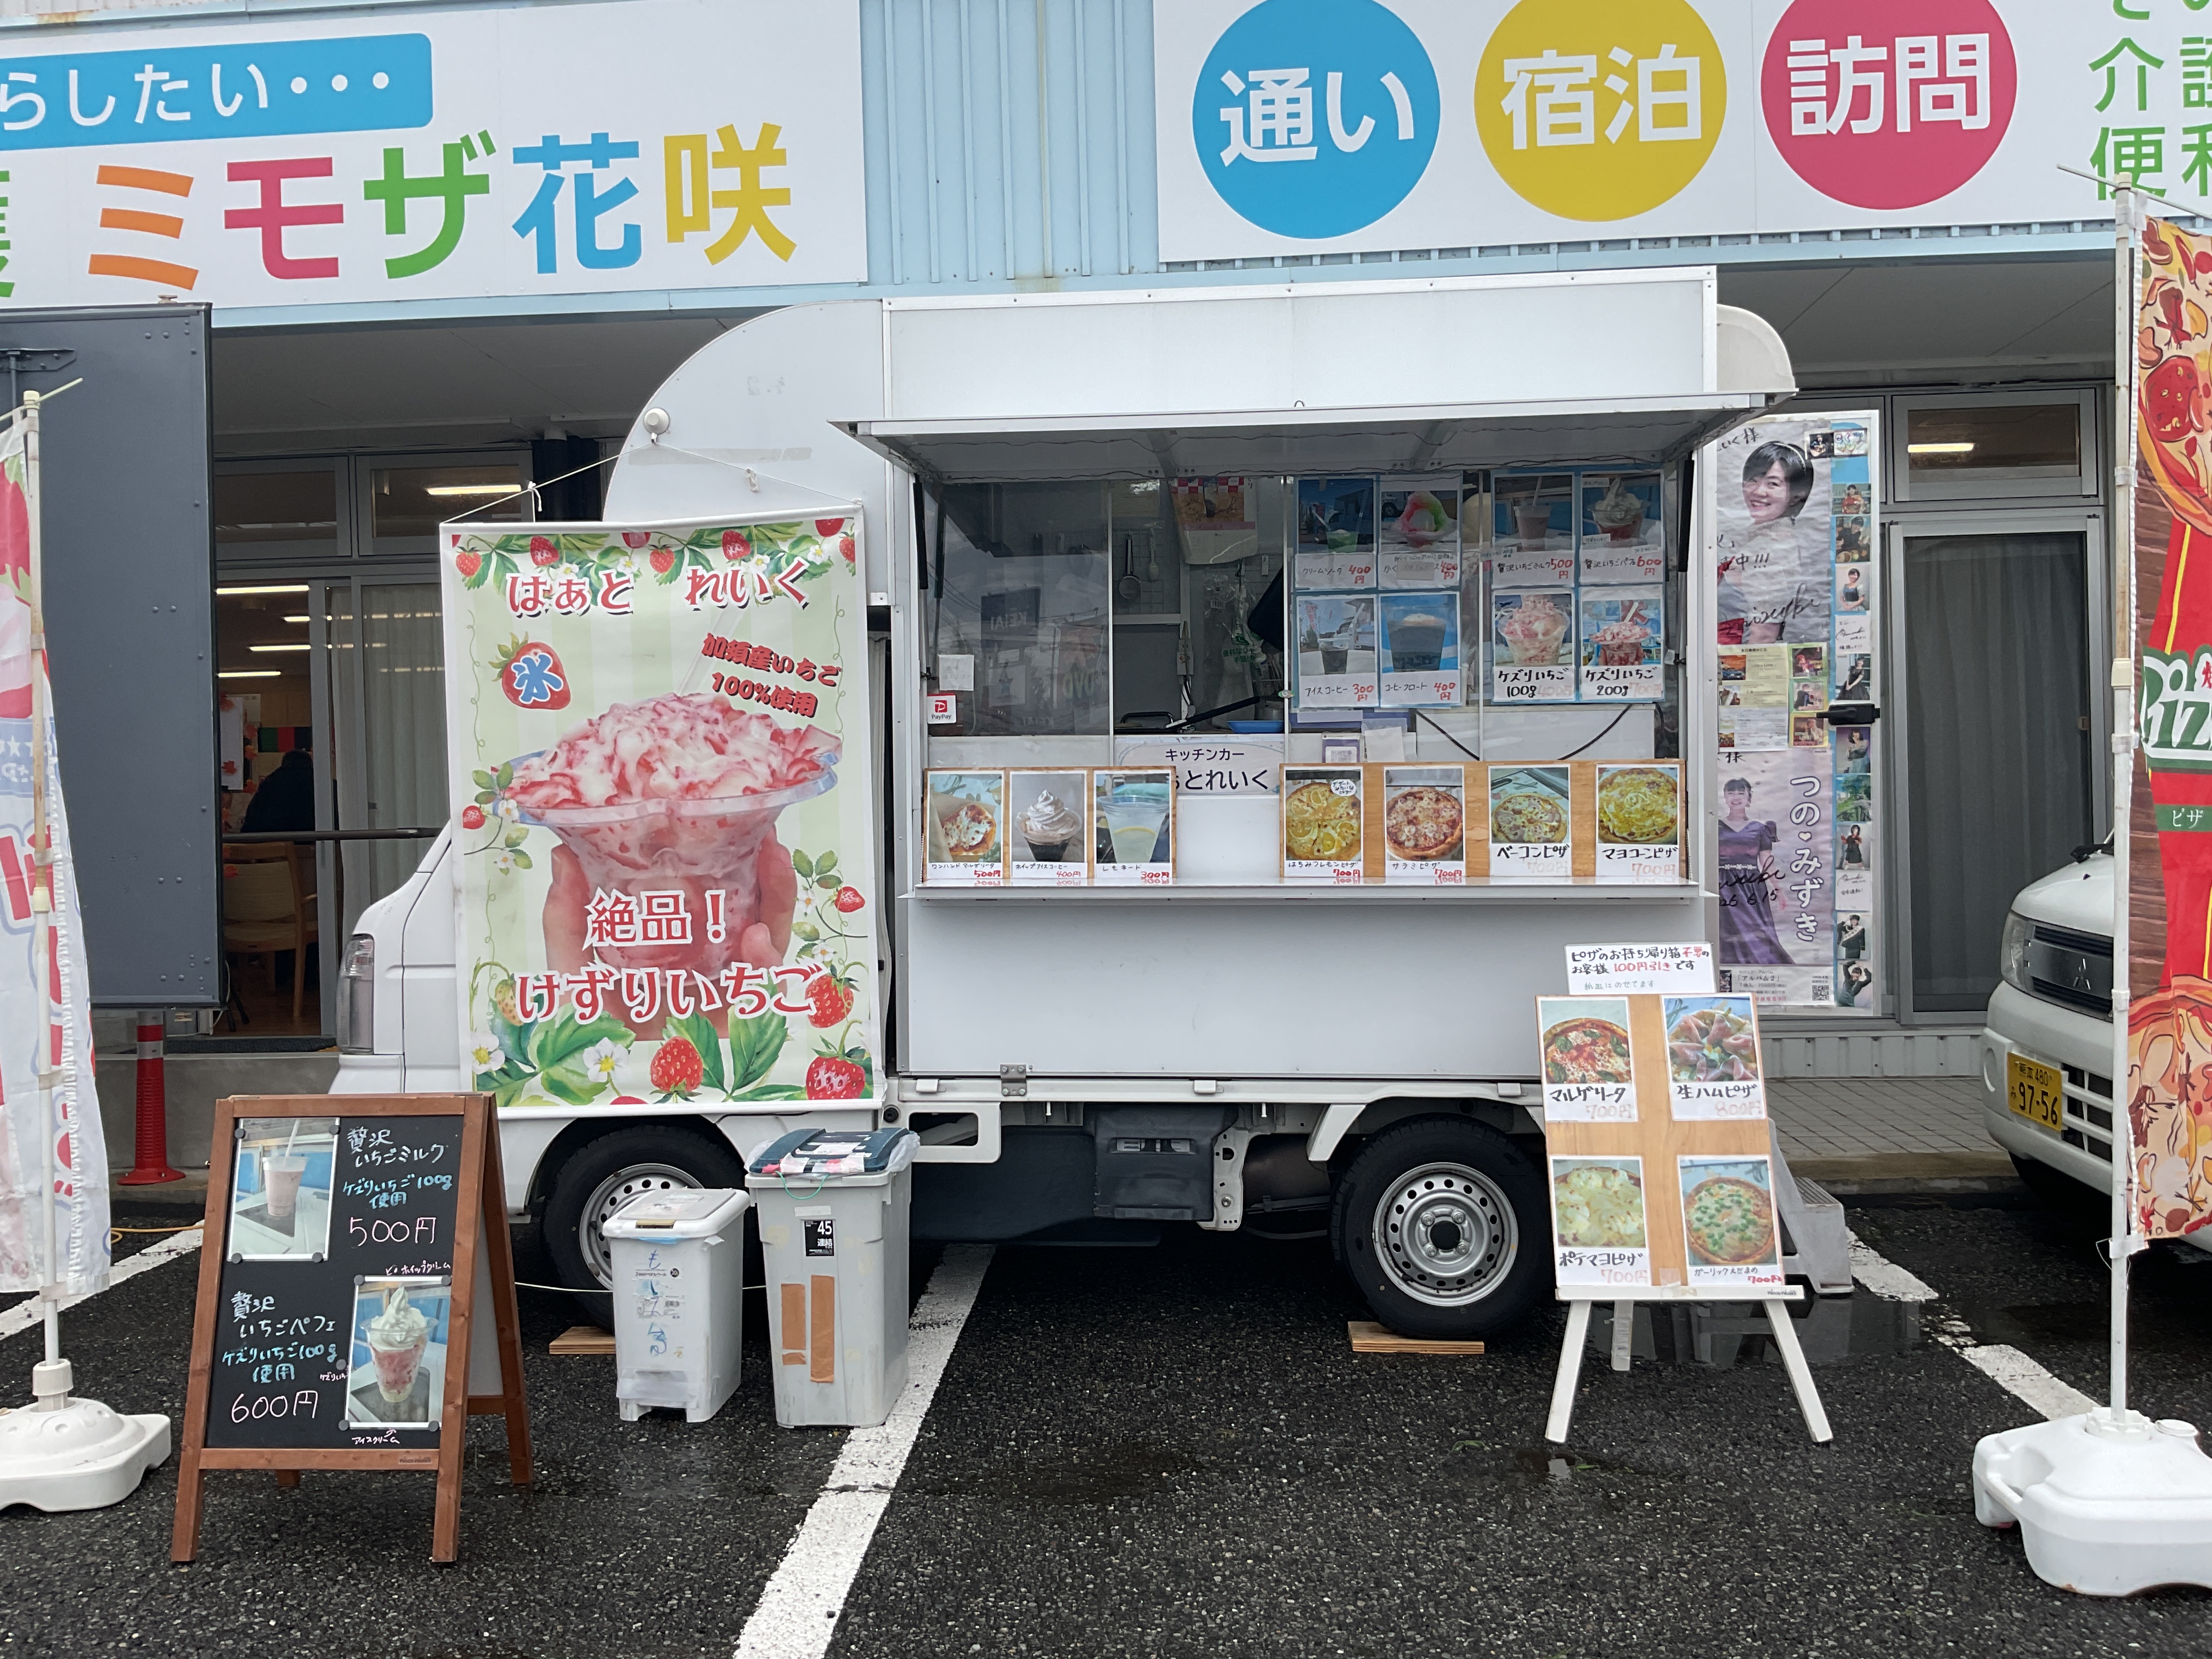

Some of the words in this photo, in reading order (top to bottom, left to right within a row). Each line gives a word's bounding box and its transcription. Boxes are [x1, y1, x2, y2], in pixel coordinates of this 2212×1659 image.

[1500, 44, 1701, 149] 宿泊
[1787, 33, 1990, 136] 訪問
[1220, 67, 1414, 167] 通い
[88, 122, 797, 291] ミモザ花咲
[507, 571, 633, 616] はぁと
[685, 557, 809, 610] れいく
[513, 653, 565, 704] 氷
[712, 672, 818, 718] 100%使用
[1165, 748, 1244, 761] キッチンカー
[2172, 808, 2204, 828] ピザ
[1497, 844, 1570, 859] ベーコンピザ
[1392, 862, 1441, 870] サラミピザ
[1435, 868, 1462, 877] 700円
[1632, 862, 1676, 876] 700円
[515, 957, 827, 1024] けずりいちご
[1549, 1086, 1626, 1103] マルゲリータ
[1677, 1084, 1758, 1100] 生ハムピザ
[2019, 1081, 2058, 1125] 97-56
[347, 1126, 393, 1154] 贅沢
[355, 1143, 448, 1167] いちごミルク
[369, 1190, 407, 1210] 使用
[350, 1217, 436, 1248] 500円
[817, 1221, 832, 1235] 45
[1559, 1251, 1643, 1267] ポテマヨピザ
[1747, 1274, 1781, 1284] 700円
[230, 1290, 275, 1322] 贅沢
[252, 1363, 295, 1384] 使用
[231, 1390, 319, 1423] 600円
